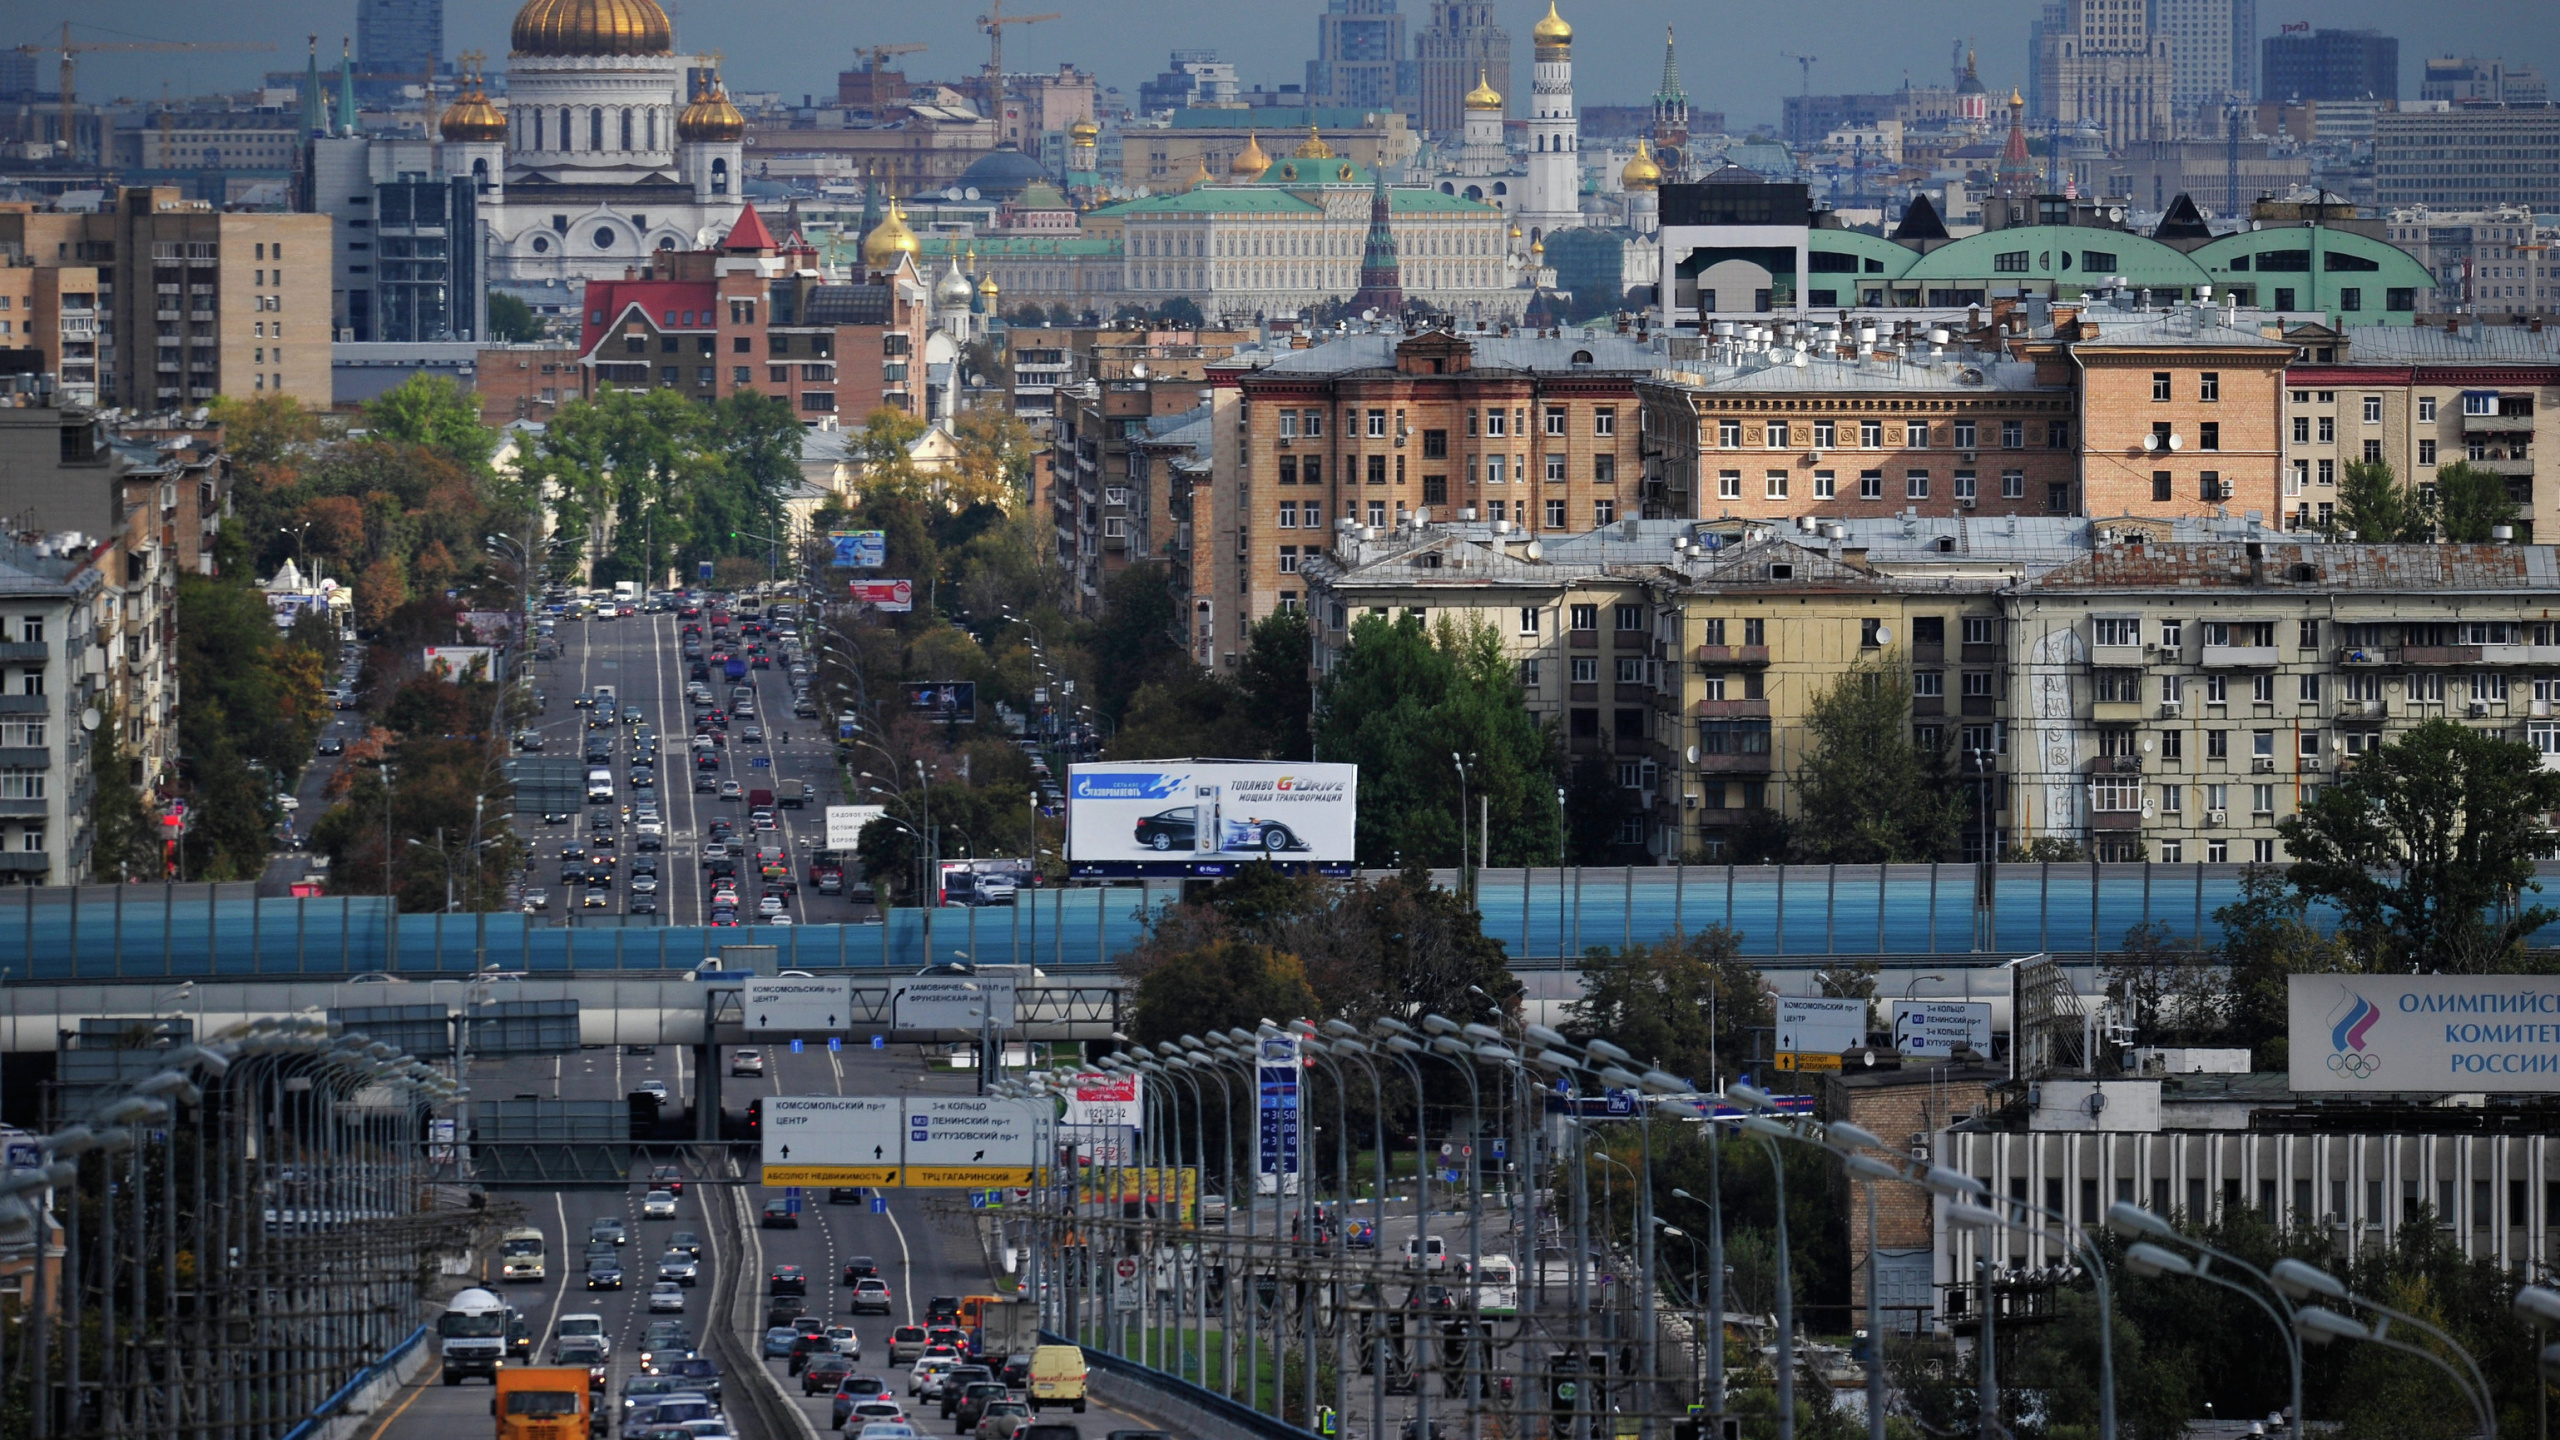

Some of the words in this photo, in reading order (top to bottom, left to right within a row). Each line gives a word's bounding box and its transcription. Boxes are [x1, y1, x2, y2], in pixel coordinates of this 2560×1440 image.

[1231, 780, 1274, 791] ТОПЛИВО
[1238, 793, 1272, 802] МОЩНАЯ
[1275, 793, 1343, 803] ТРАНСФОРМАЦИЯ
[752, 985, 825, 993] КОМСОМОЛЬСКИЙ
[752, 995, 779, 1003] ЦЕНТР
[1784, 1002, 1843, 1011] КОМСОМОЛЬСКИЙ
[1938, 1005, 1965, 1014] КОЛЬЦО
[1926, 1015, 1966, 1023] ЛЕНИНСКИЙ
[1937, 1028, 1965, 1036] КОЛЬЦО
[2445, 1024, 2560, 1043] КОМИТЕТ
[2451, 1053, 2558, 1073] РОССИИ
[775, 1100, 864, 1110] КОМСОМОЛЬСКИЙ
[866, 1103, 886, 1111] пр-т
[932, 1102, 945, 1110] 3-е
[947, 1102, 987, 1111] КОЛЬЦО
[1611, 1097, 1627, 1109] ТНК
[776, 1116, 808, 1125] ЦЕНТР
[931, 1116, 989, 1125] ЛЕНИНСКИЙ
[991, 1118, 1011, 1127] пр-т
[931, 1130, 998, 1140] КУТУЗОВСКИЙ
[1000, 1133, 1019, 1141] пр-т
[1270, 1162, 1288, 1171] АС
[767, 1172, 809, 1180] АБСОЛЮТ
[811, 1172, 882, 1181] НЕДВИЖИМОСТЬ
[922, 1172, 940, 1181] ТРЦ
[942, 1171, 1009, 1181] ГАГАРИНСКИЙ
